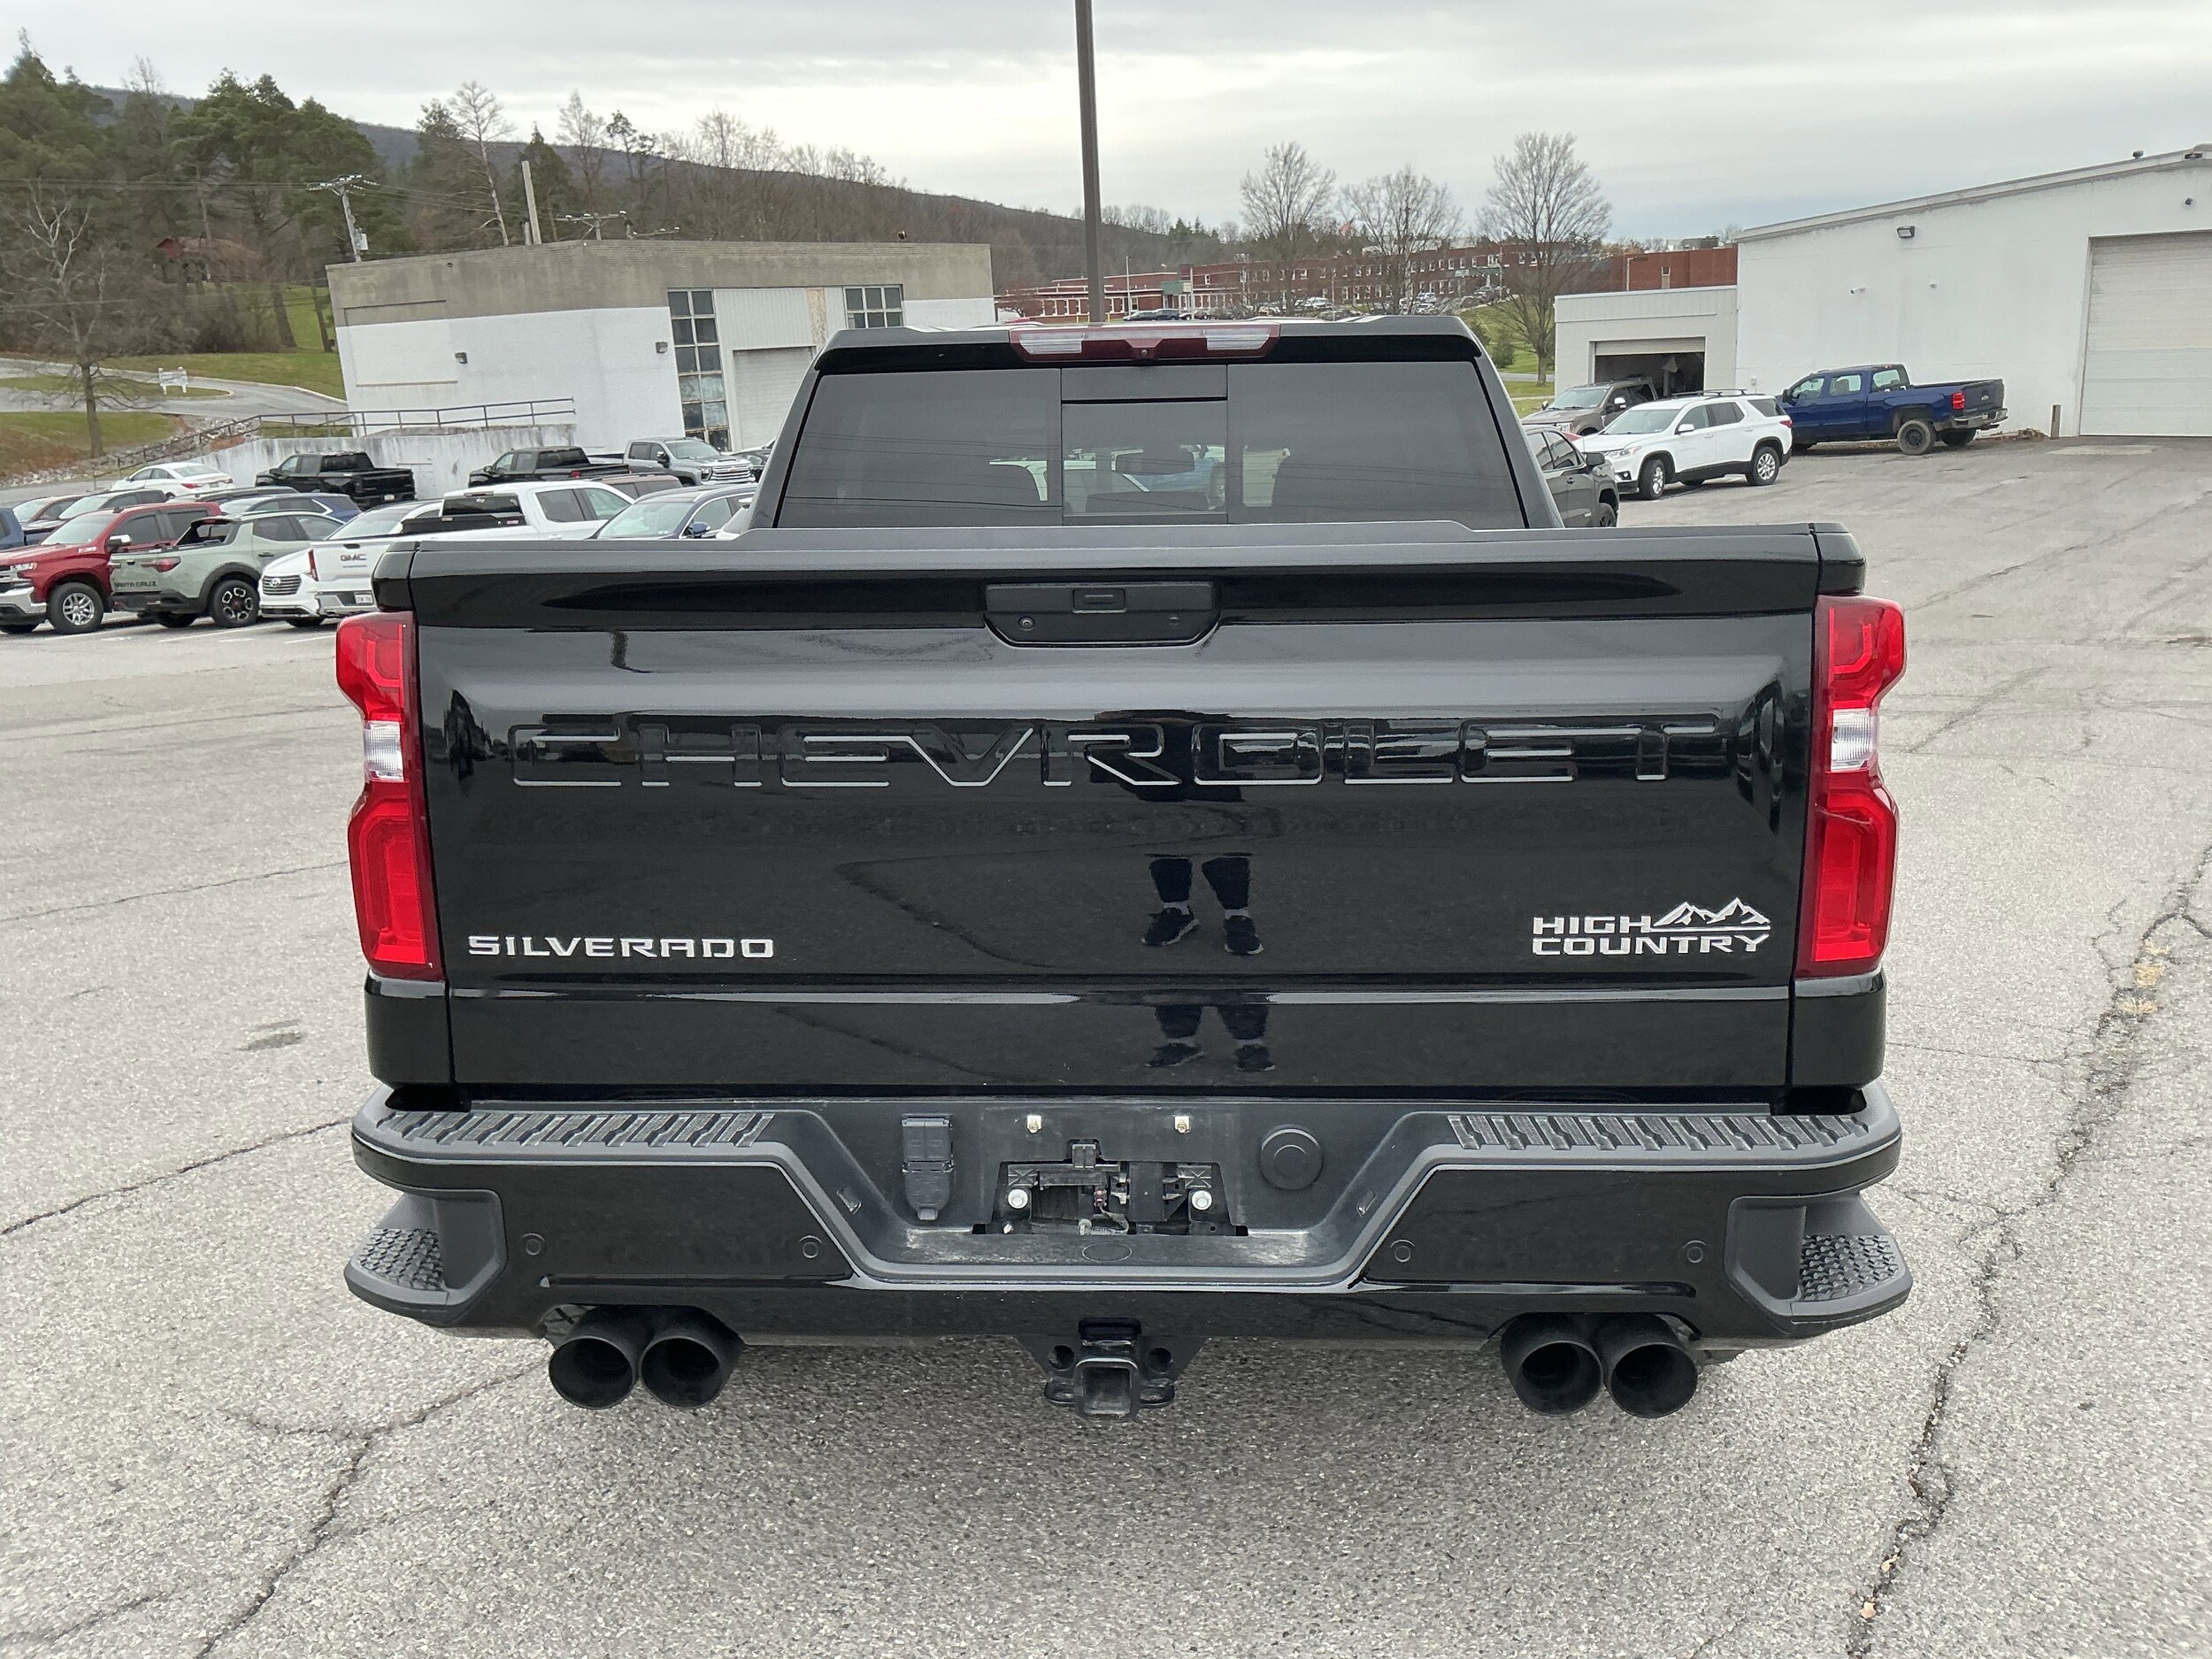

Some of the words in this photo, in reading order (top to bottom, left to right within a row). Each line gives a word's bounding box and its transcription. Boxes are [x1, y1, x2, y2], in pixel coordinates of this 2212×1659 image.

[509, 715, 1722, 786] CHEVROLET
[1532, 915, 1652, 934] HIGH
[468, 936, 774, 958] SILVERADO
[1532, 933, 1770, 956] COUNTRY
